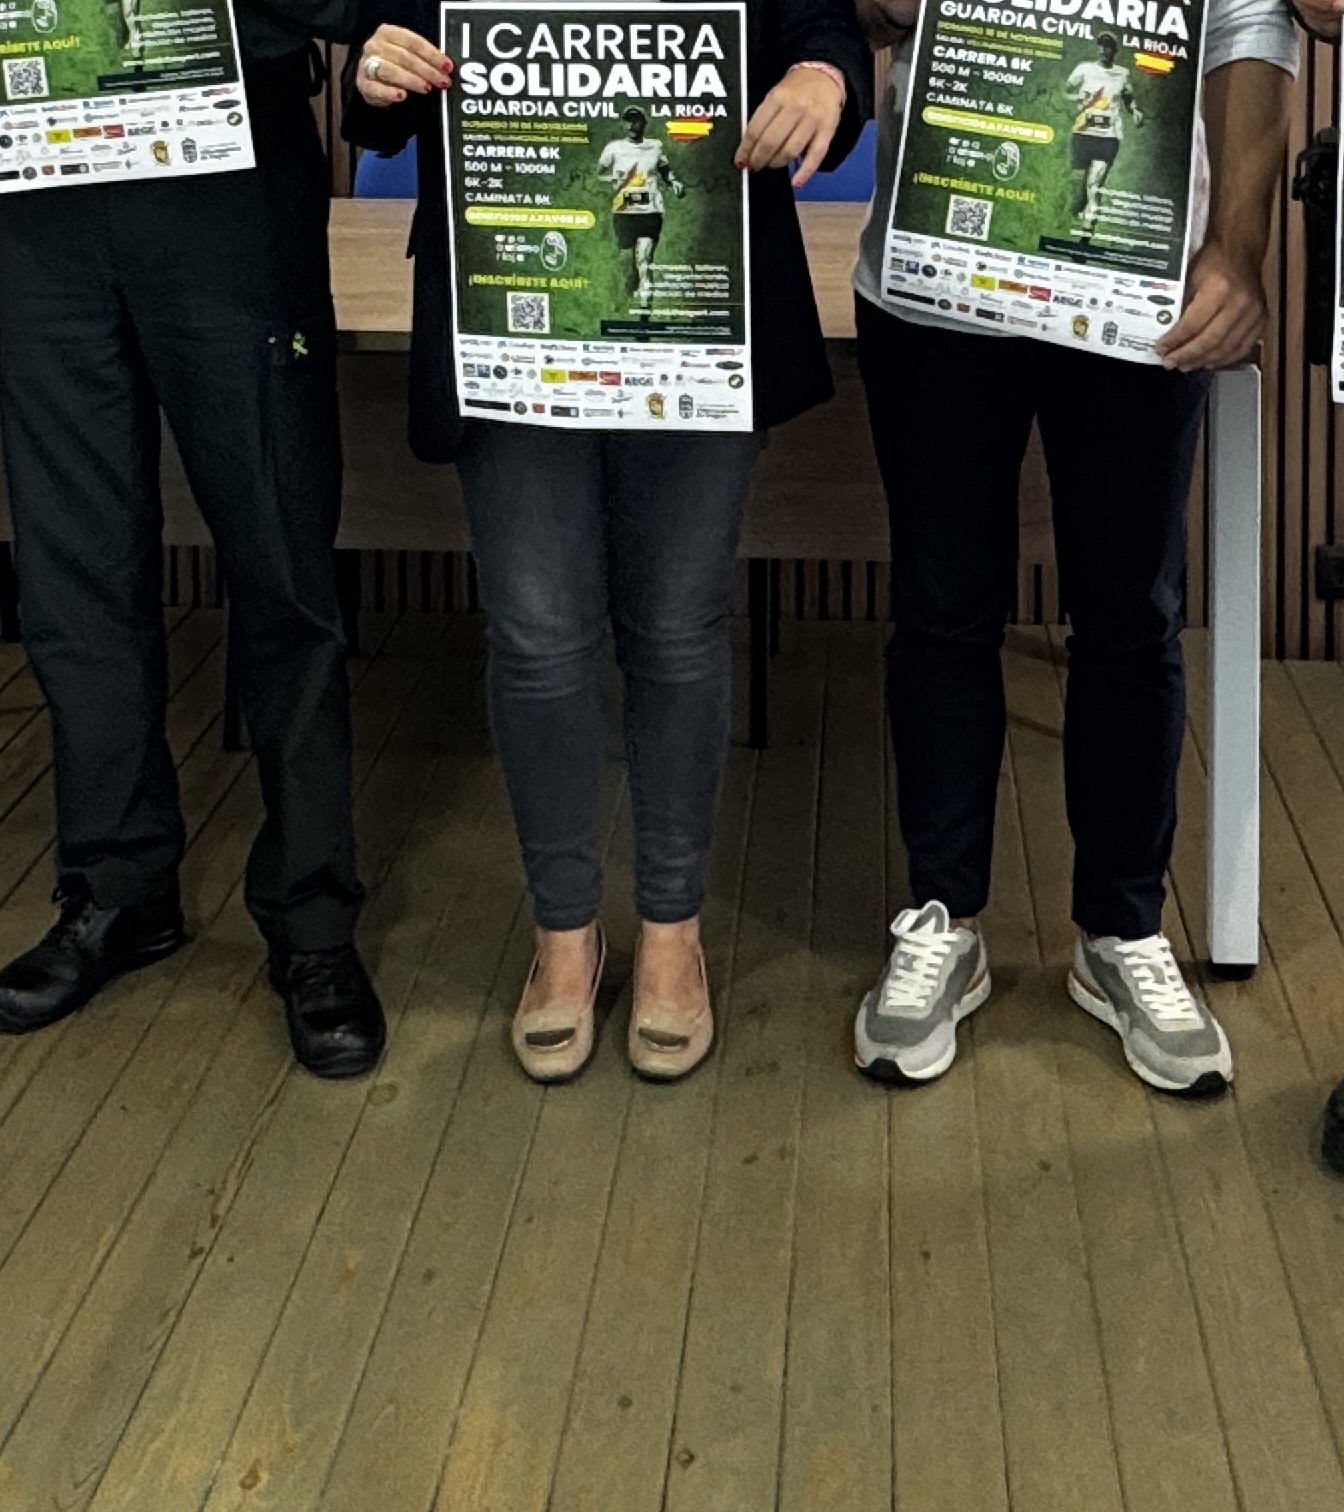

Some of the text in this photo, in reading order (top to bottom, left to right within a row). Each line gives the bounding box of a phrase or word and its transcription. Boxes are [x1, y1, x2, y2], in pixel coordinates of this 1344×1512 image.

[462, 22, 725, 60] I CARRERA
[940, 1, 1037, 31] GUARDIA
[1042, 18, 1094, 40] CIVIL
[1122, 34, 1140, 49] LA
[1143, 38, 1188, 60] RIOJA
[933, 45, 1008, 68] CARRERA
[459, 62, 728, 98] SOLIDARIA
[461, 99, 728, 118] GUARDIA CIVIL LA RIOJA
[463, 145, 537, 159] CARRERA
